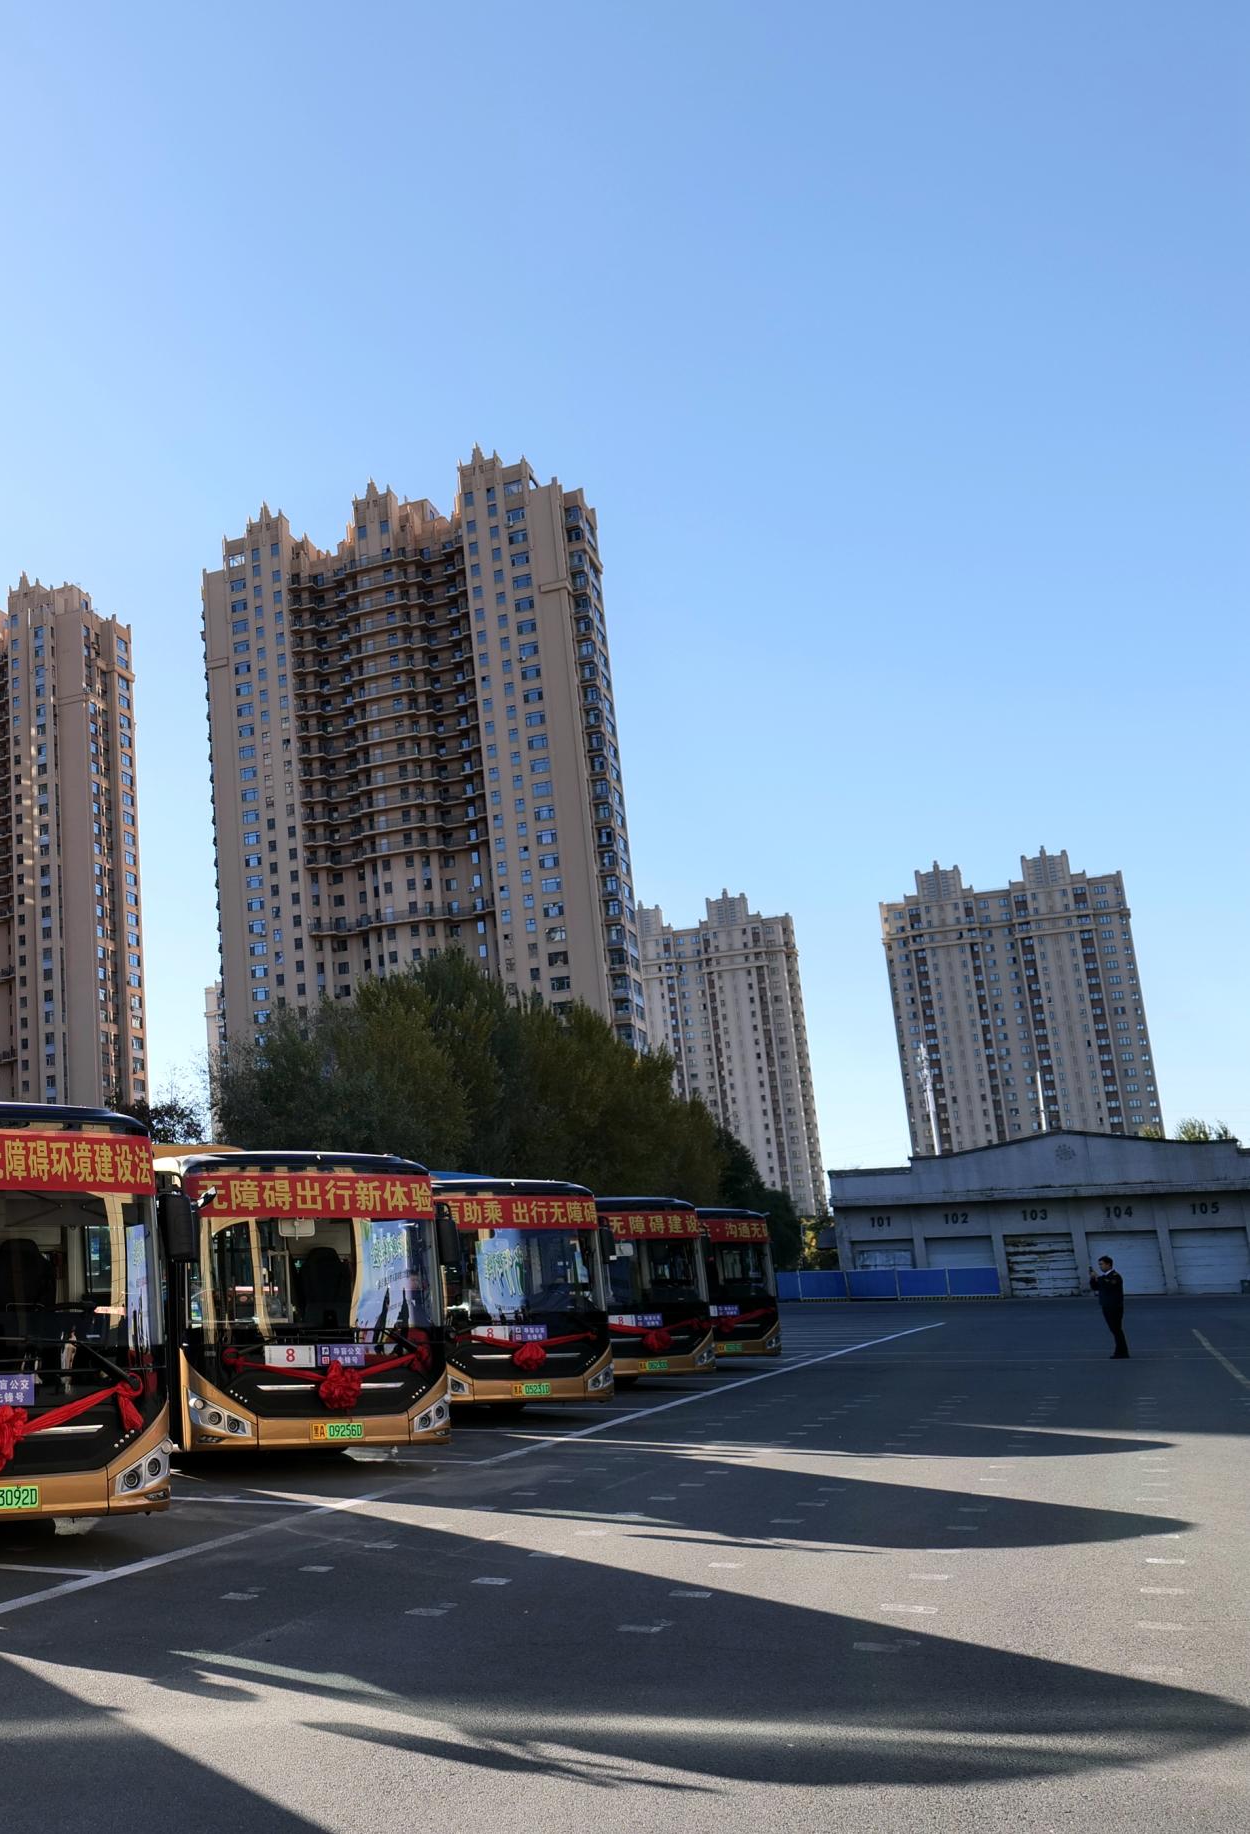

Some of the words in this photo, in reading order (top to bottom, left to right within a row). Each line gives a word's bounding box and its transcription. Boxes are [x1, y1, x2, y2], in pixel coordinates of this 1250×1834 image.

[198, 1178, 434, 1212] 无障碍出行新体验
[512, 1201, 598, 1224] 出行无障碍
[1022, 1209, 1048, 1222] 103
[1105, 1205, 1133, 1219] 104
[1189, 1202, 1221, 1215] 105
[609, 1214, 699, 1235] 无障碍建设
[870, 1216, 892, 1228] 101
[943, 1212, 969, 1225] 102
[286, 1348, 296, 1362] 8
